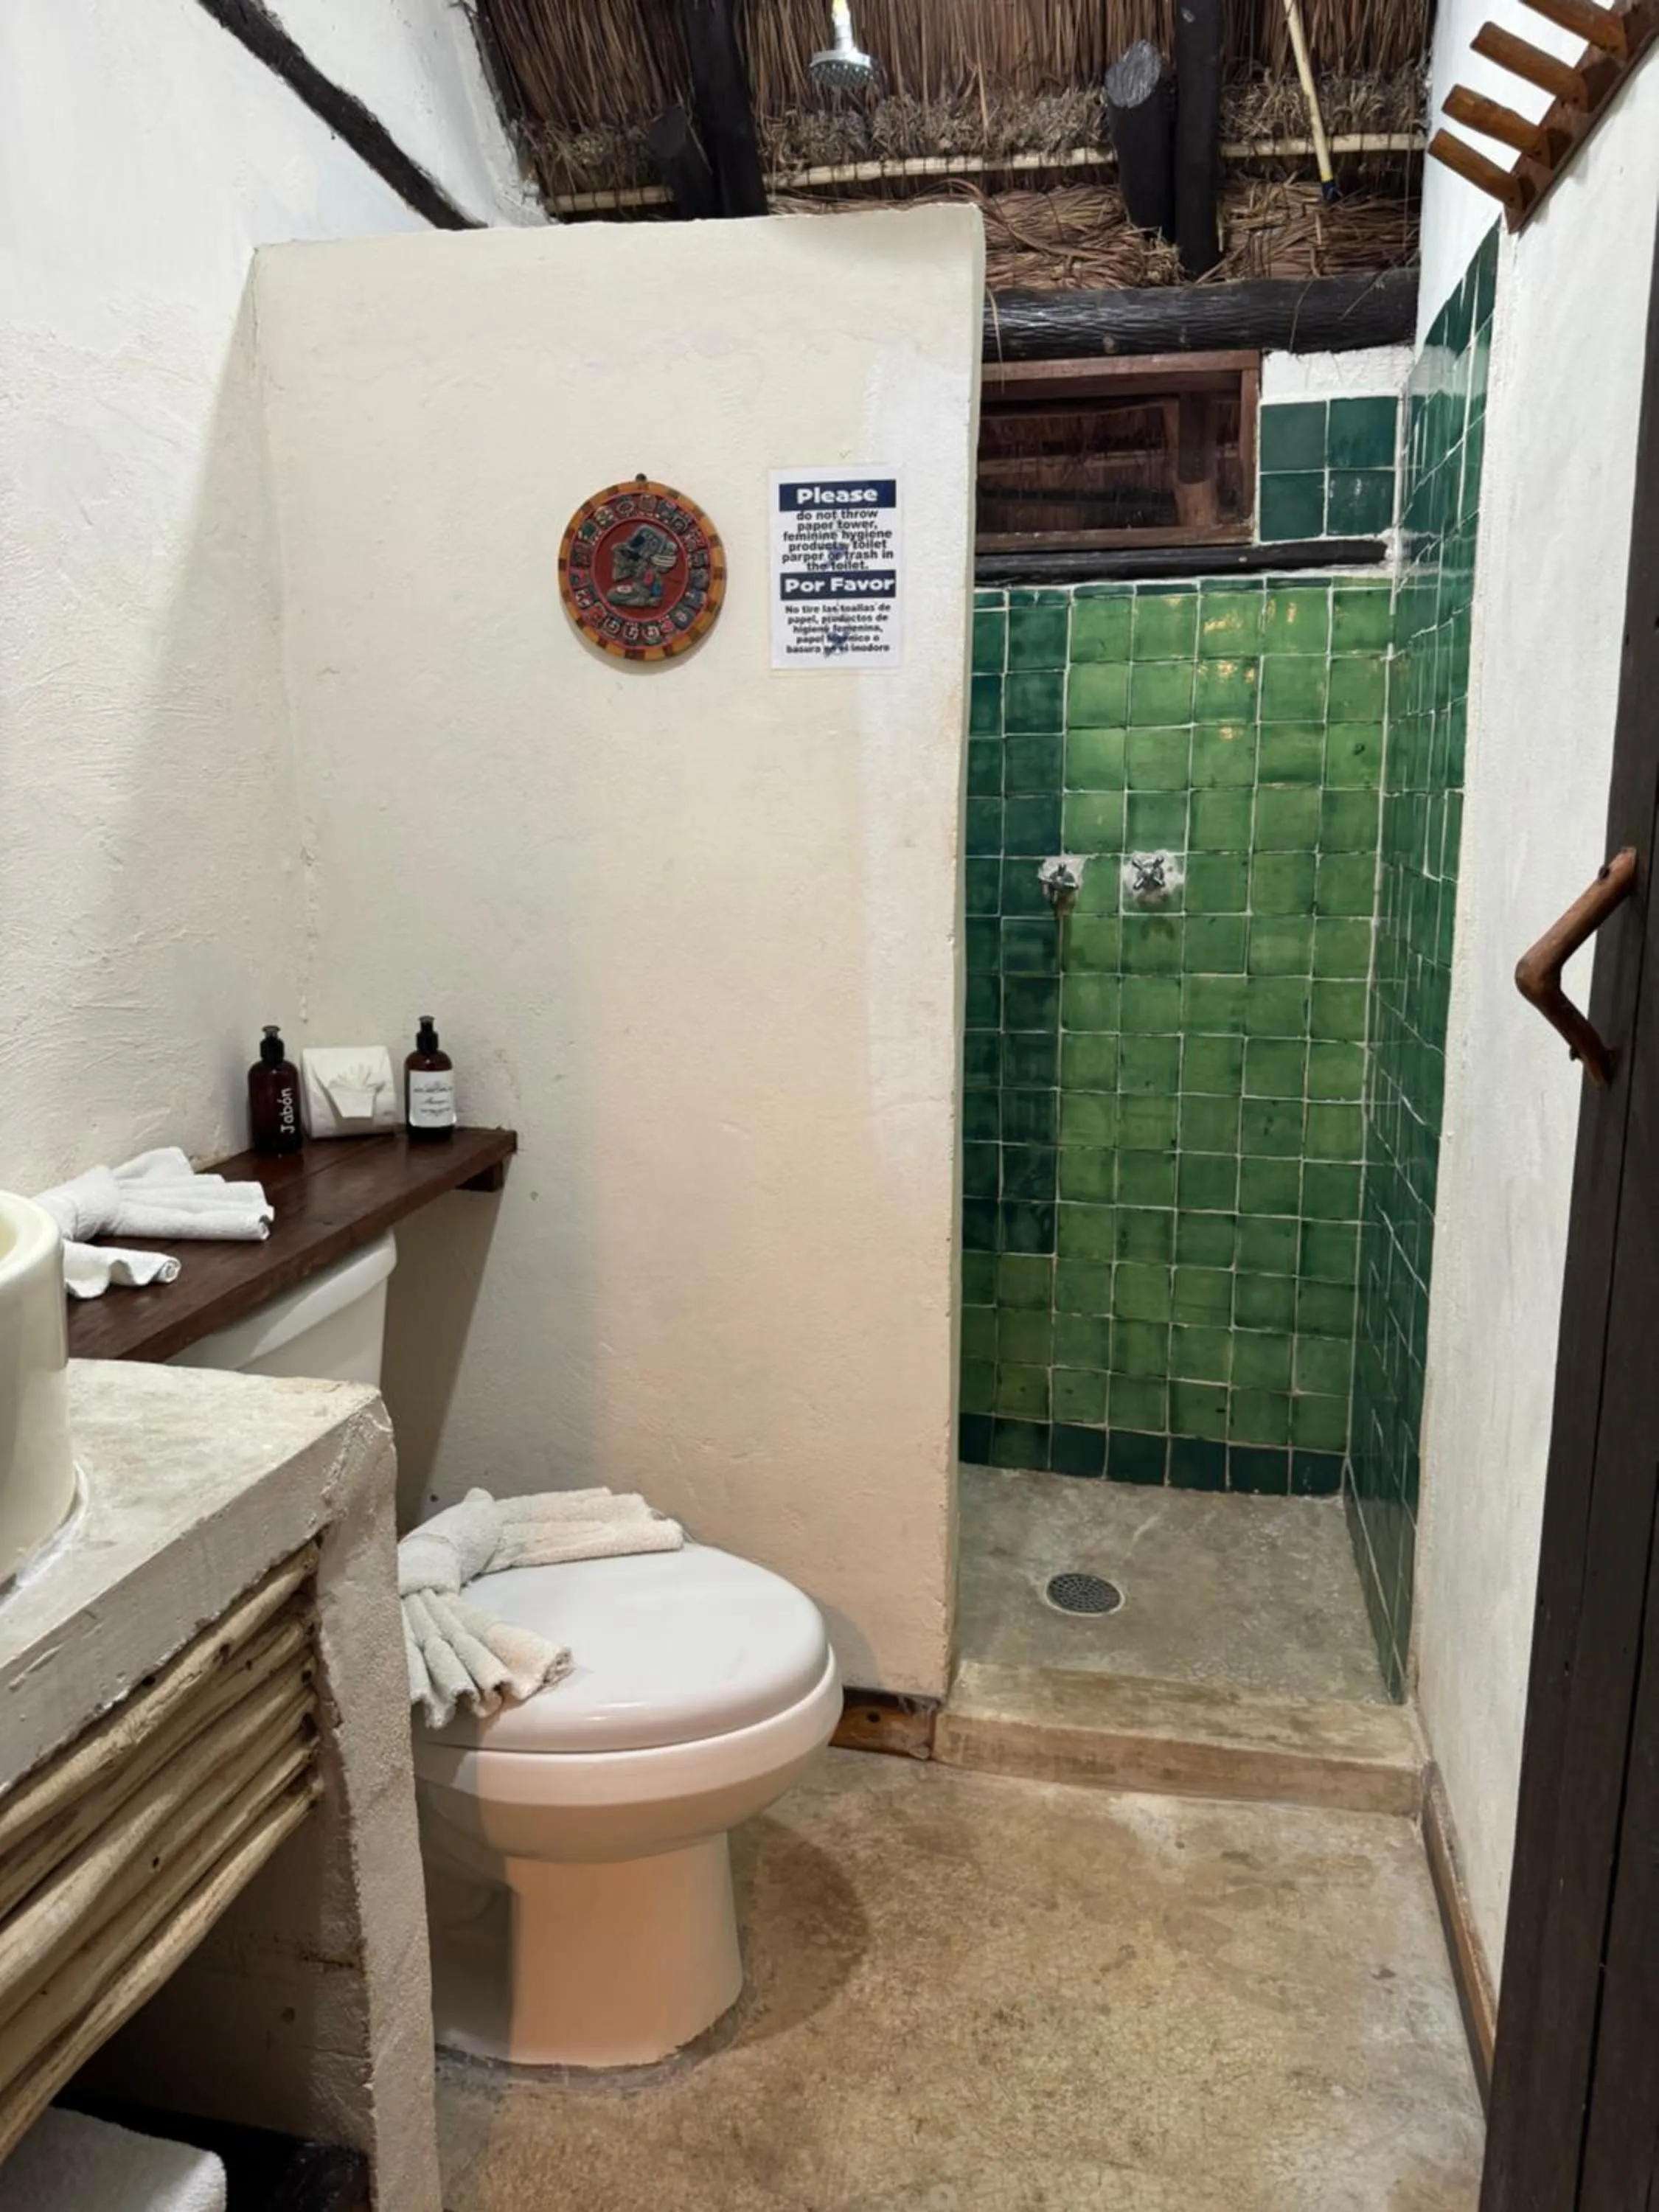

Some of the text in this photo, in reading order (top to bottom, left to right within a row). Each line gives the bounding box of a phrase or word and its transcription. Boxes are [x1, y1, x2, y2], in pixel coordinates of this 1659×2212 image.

[797, 487, 878, 504] Please
[796, 509, 878, 520] do not throw
[798, 521, 834, 532] paper
[783, 529, 893, 541] feminine hygiene
[853, 540, 887, 549] toilet
[782, 552, 824, 564] parper
[845, 550, 877, 559] trash
[881, 549, 894, 559] in
[807, 561, 827, 571] the
[785, 577, 894, 592] Por Favor
[785, 605, 800, 613] No
[823, 604, 838, 612] las
[840, 604, 875, 612] toallas
[877, 603, 891, 611] de
[875, 613, 888, 622] de
[796, 634, 824, 644] papel
[786, 645, 821, 654] basura
[850, 643, 890, 652] inodoro
[276, 1088, 296, 1134] Jabón
